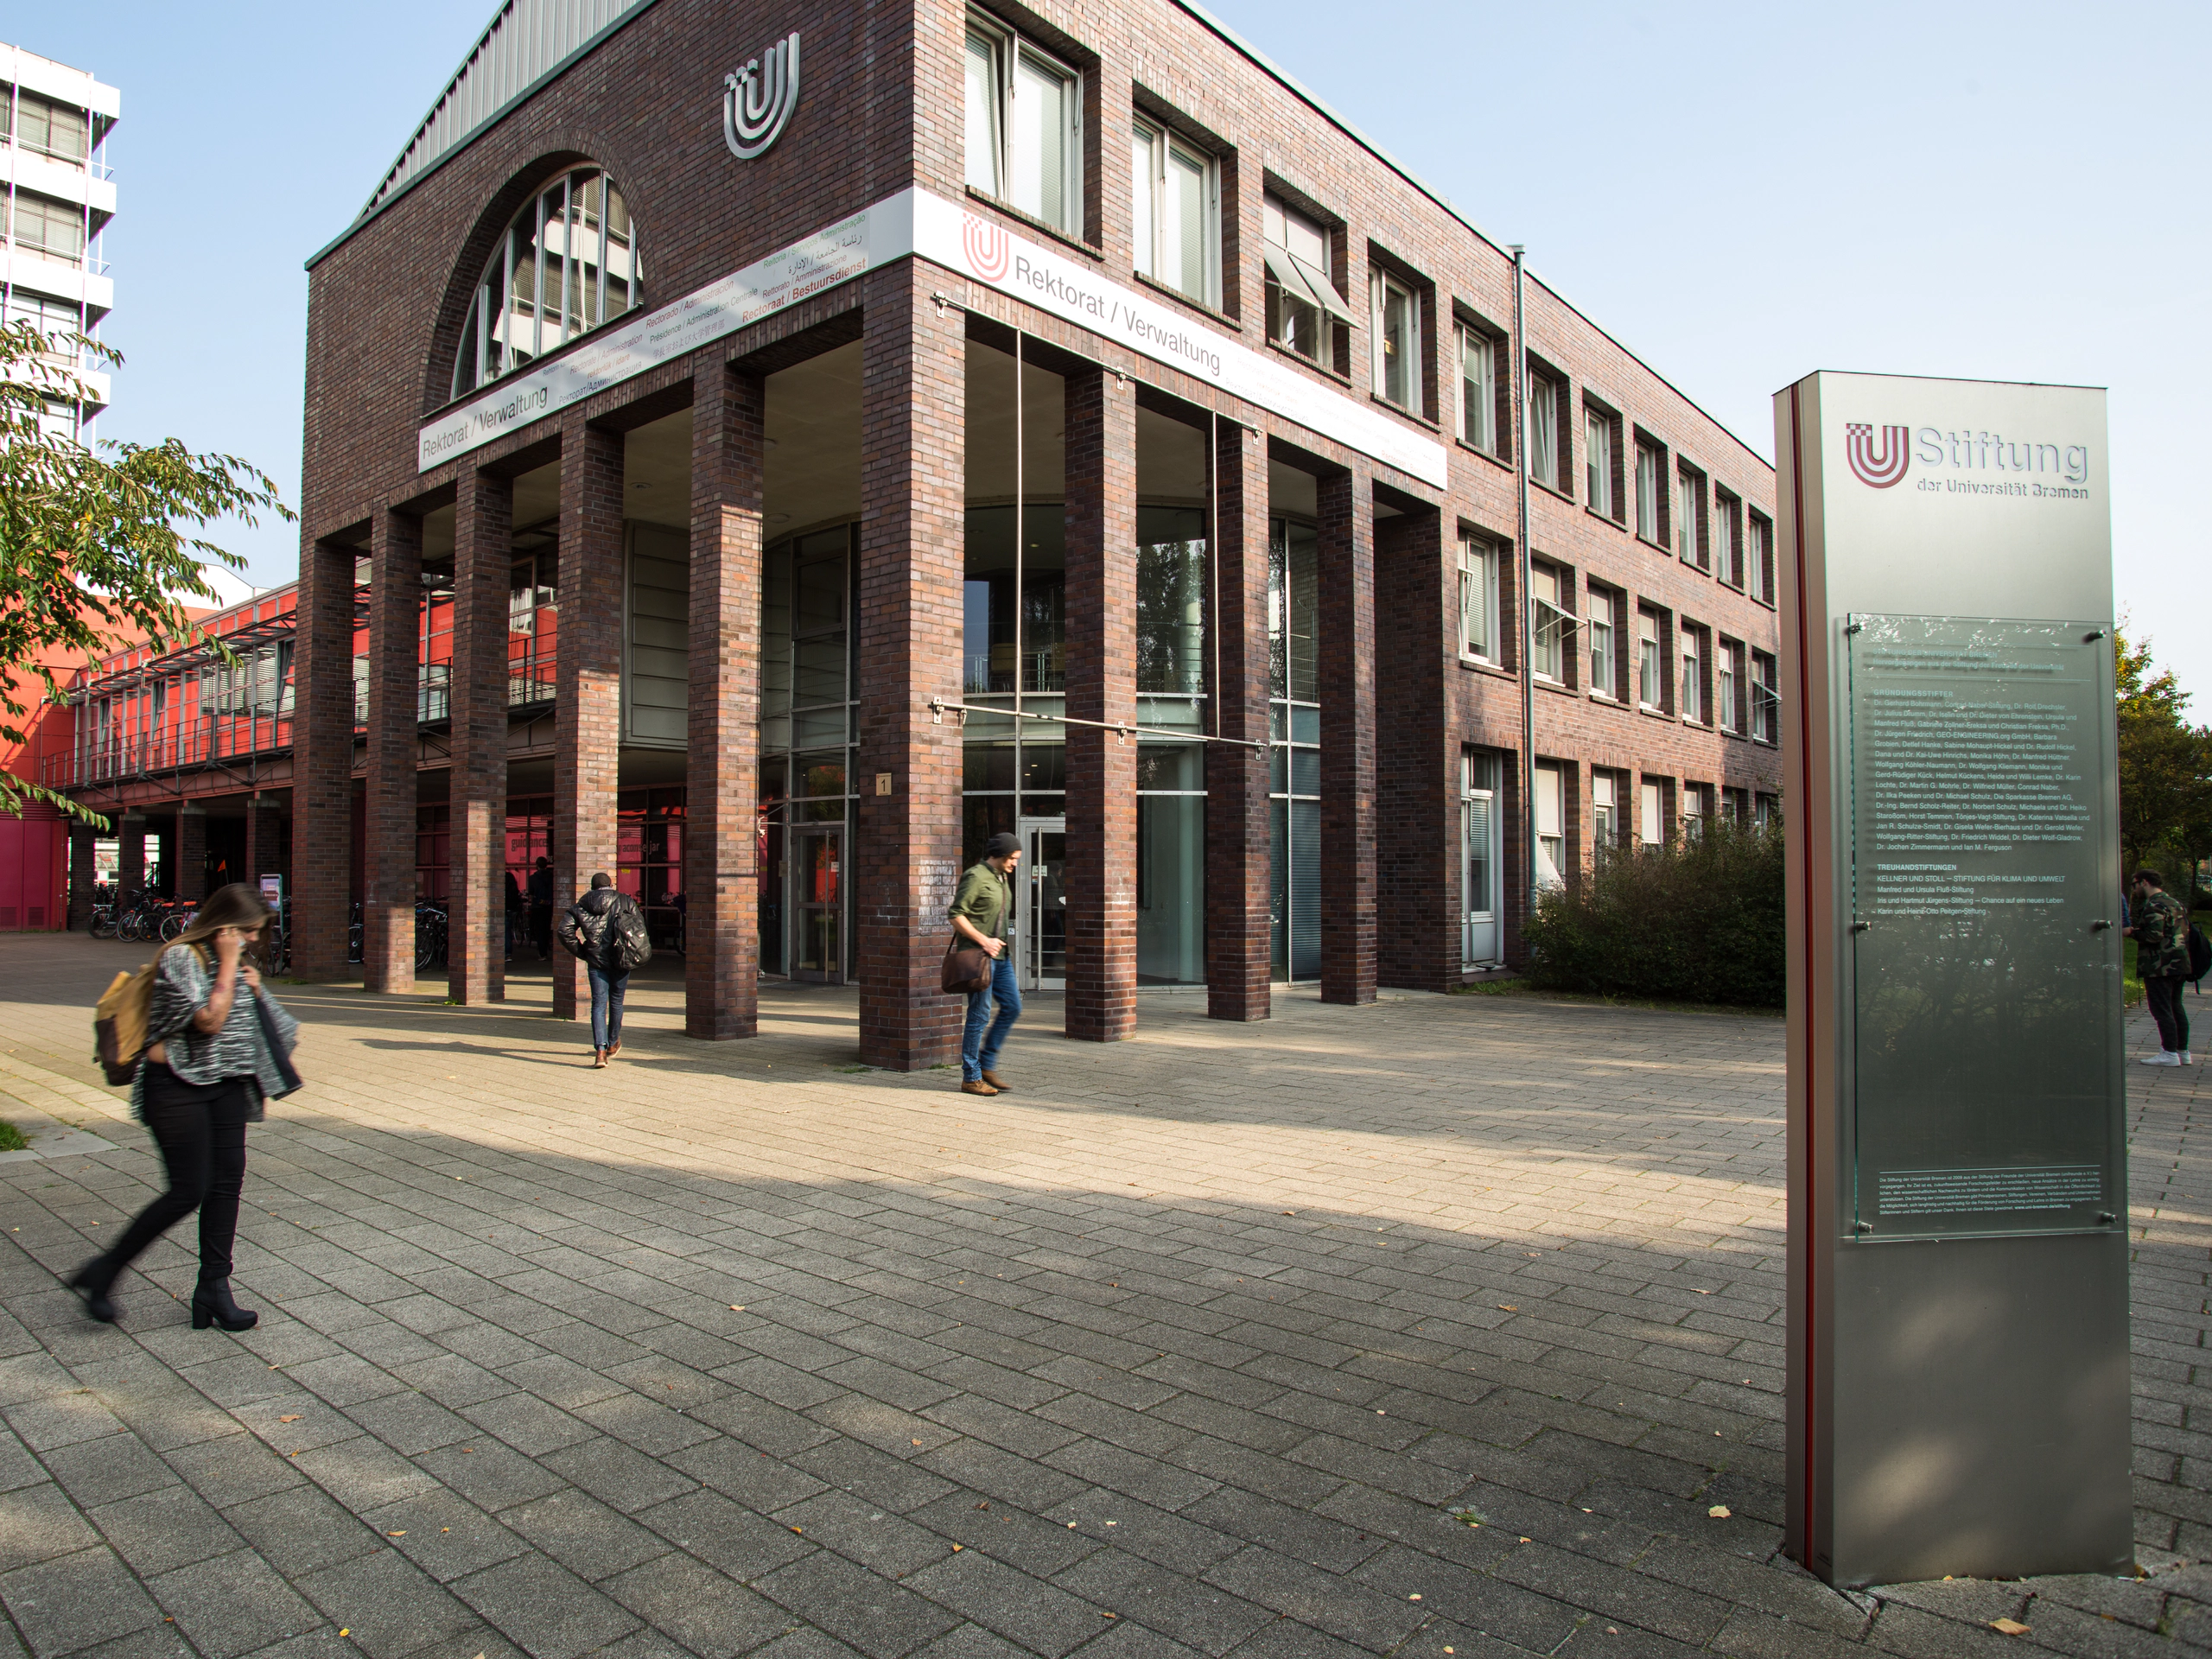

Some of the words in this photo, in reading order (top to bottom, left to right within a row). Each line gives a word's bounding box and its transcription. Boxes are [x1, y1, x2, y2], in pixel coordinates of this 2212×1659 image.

[763, 251, 786, 269] Reitoria
[791, 238, 818, 256] Serviços
[819, 213, 866, 241] Administração
[742, 294, 785, 322] Rectoraat
[792, 257, 867, 300] Bestuursdienst
[762, 282, 790, 298] Rettorato
[795, 253, 848, 283] Amministrazione
[645, 307, 678, 329] Rectorado
[683, 279, 734, 311] Administración
[650, 323, 682, 345] Présidence
[686, 302, 729, 327] Administration
[730, 287, 758, 307] Centrale
[1016, 255, 1104, 319] Rektorat
[1110, 302, 1118, 323] /
[1124, 306, 1219, 376] Verwaltung
[569, 356, 596, 375] Rectorate
[601, 334, 643, 360] Administration
[423, 422, 468, 459] Rektorat
[471, 415, 477, 437] /
[480, 386, 548, 431] Verwaltung
[1916, 428, 2088, 484] Stiftung
[1917, 479, 1942, 492] der
[1947, 480, 2027, 497] Universität
[2032, 484, 2088, 499] Bremen
[1872, 688, 1954, 697] GRÜNDUNGSSTIFTER
[1875, 761, 1904, 770] Wolfgang
[1904, 761, 1957, 770] Köhler-Naumann,
[1967, 762, 1997, 771] Wolfgang
[880, 779, 886, 792] 1
[1876, 802, 1898, 810] Dr.-Ing.
[1876, 833, 1949, 842] Wolfgang-Ritter-Stiftung,
[1983, 843, 2012, 852] Ferguson
[1936, 886, 1974, 894] Fluß-Stiftung
[1939, 907, 1986, 916] Peitgen-Stiftung
